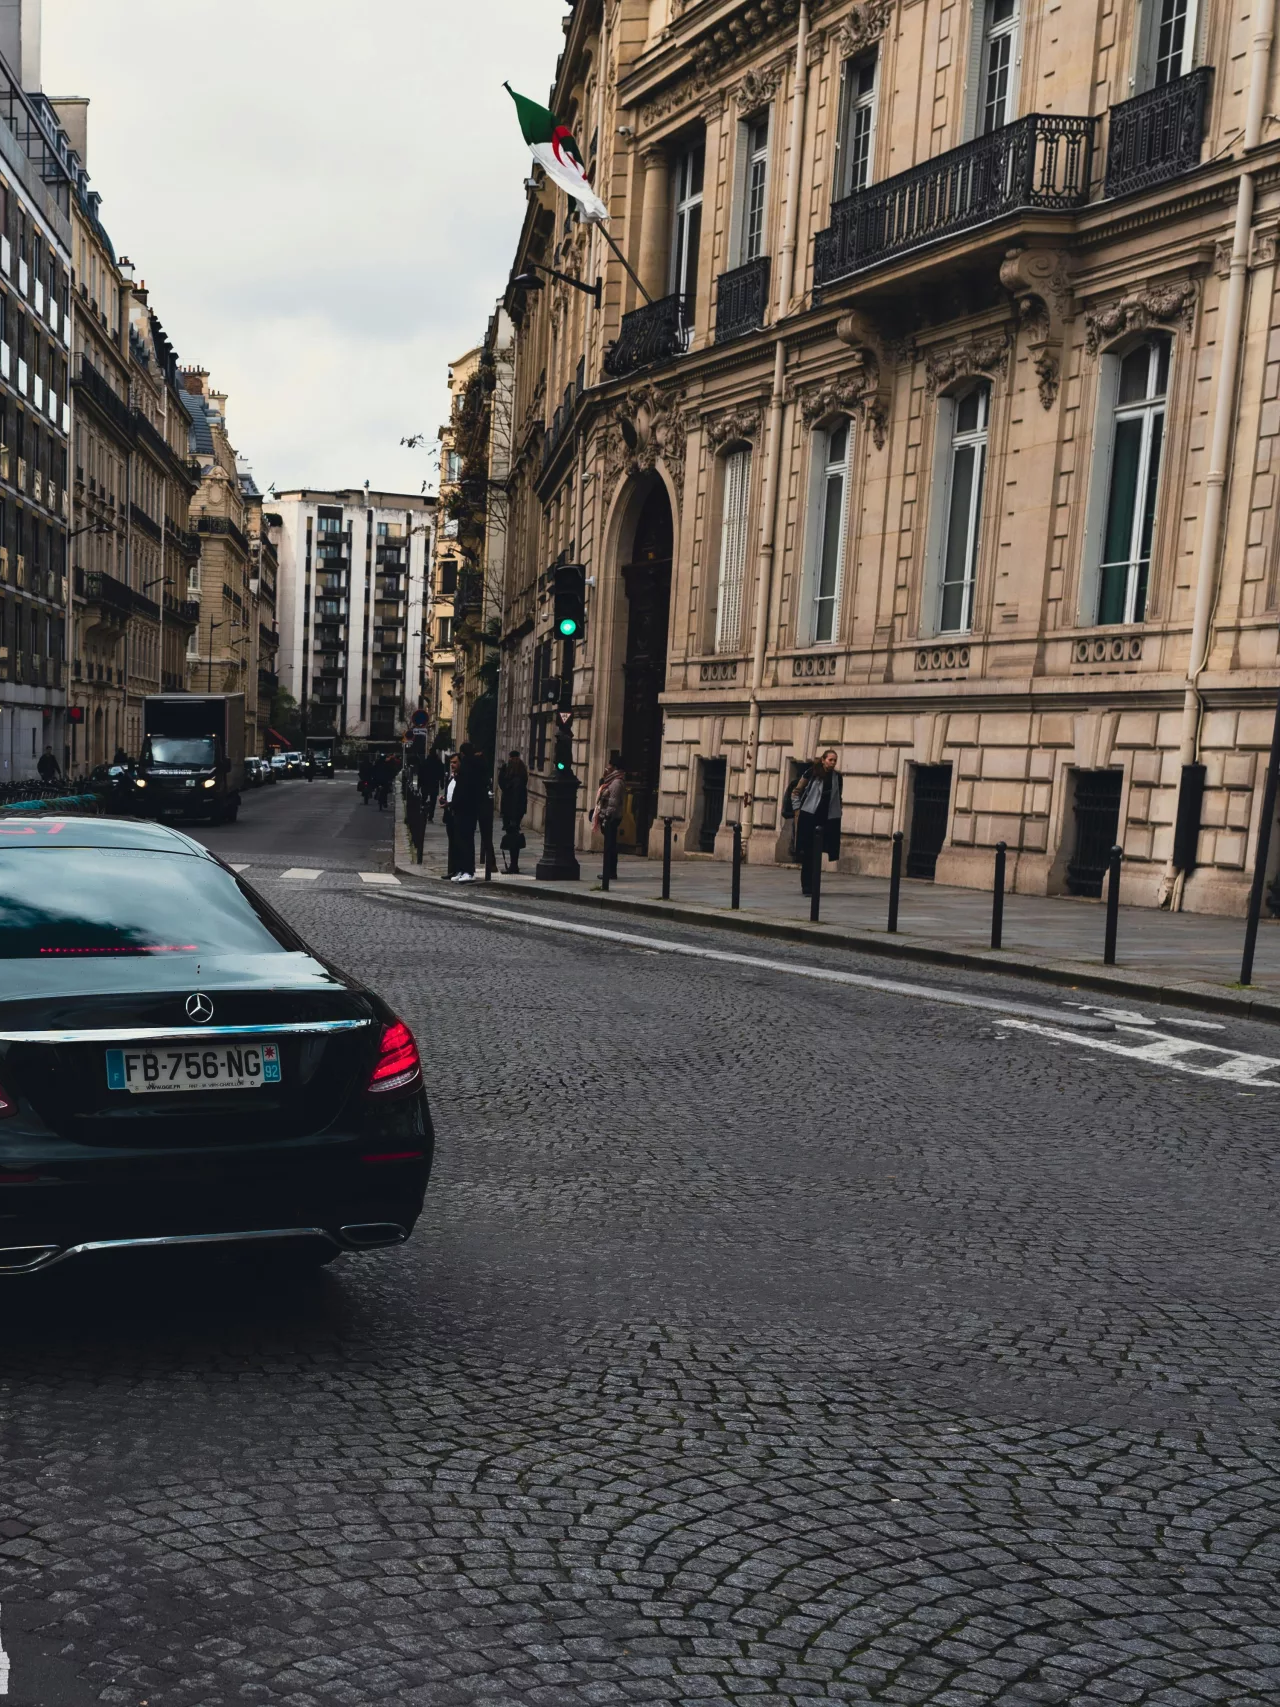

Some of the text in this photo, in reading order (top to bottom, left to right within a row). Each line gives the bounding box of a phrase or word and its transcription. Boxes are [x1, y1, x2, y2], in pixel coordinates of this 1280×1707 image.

[125, 1049, 261, 1082] FB-756-NG
[265, 1064, 278, 1079] 92
[113, 1072, 120, 1082] F
